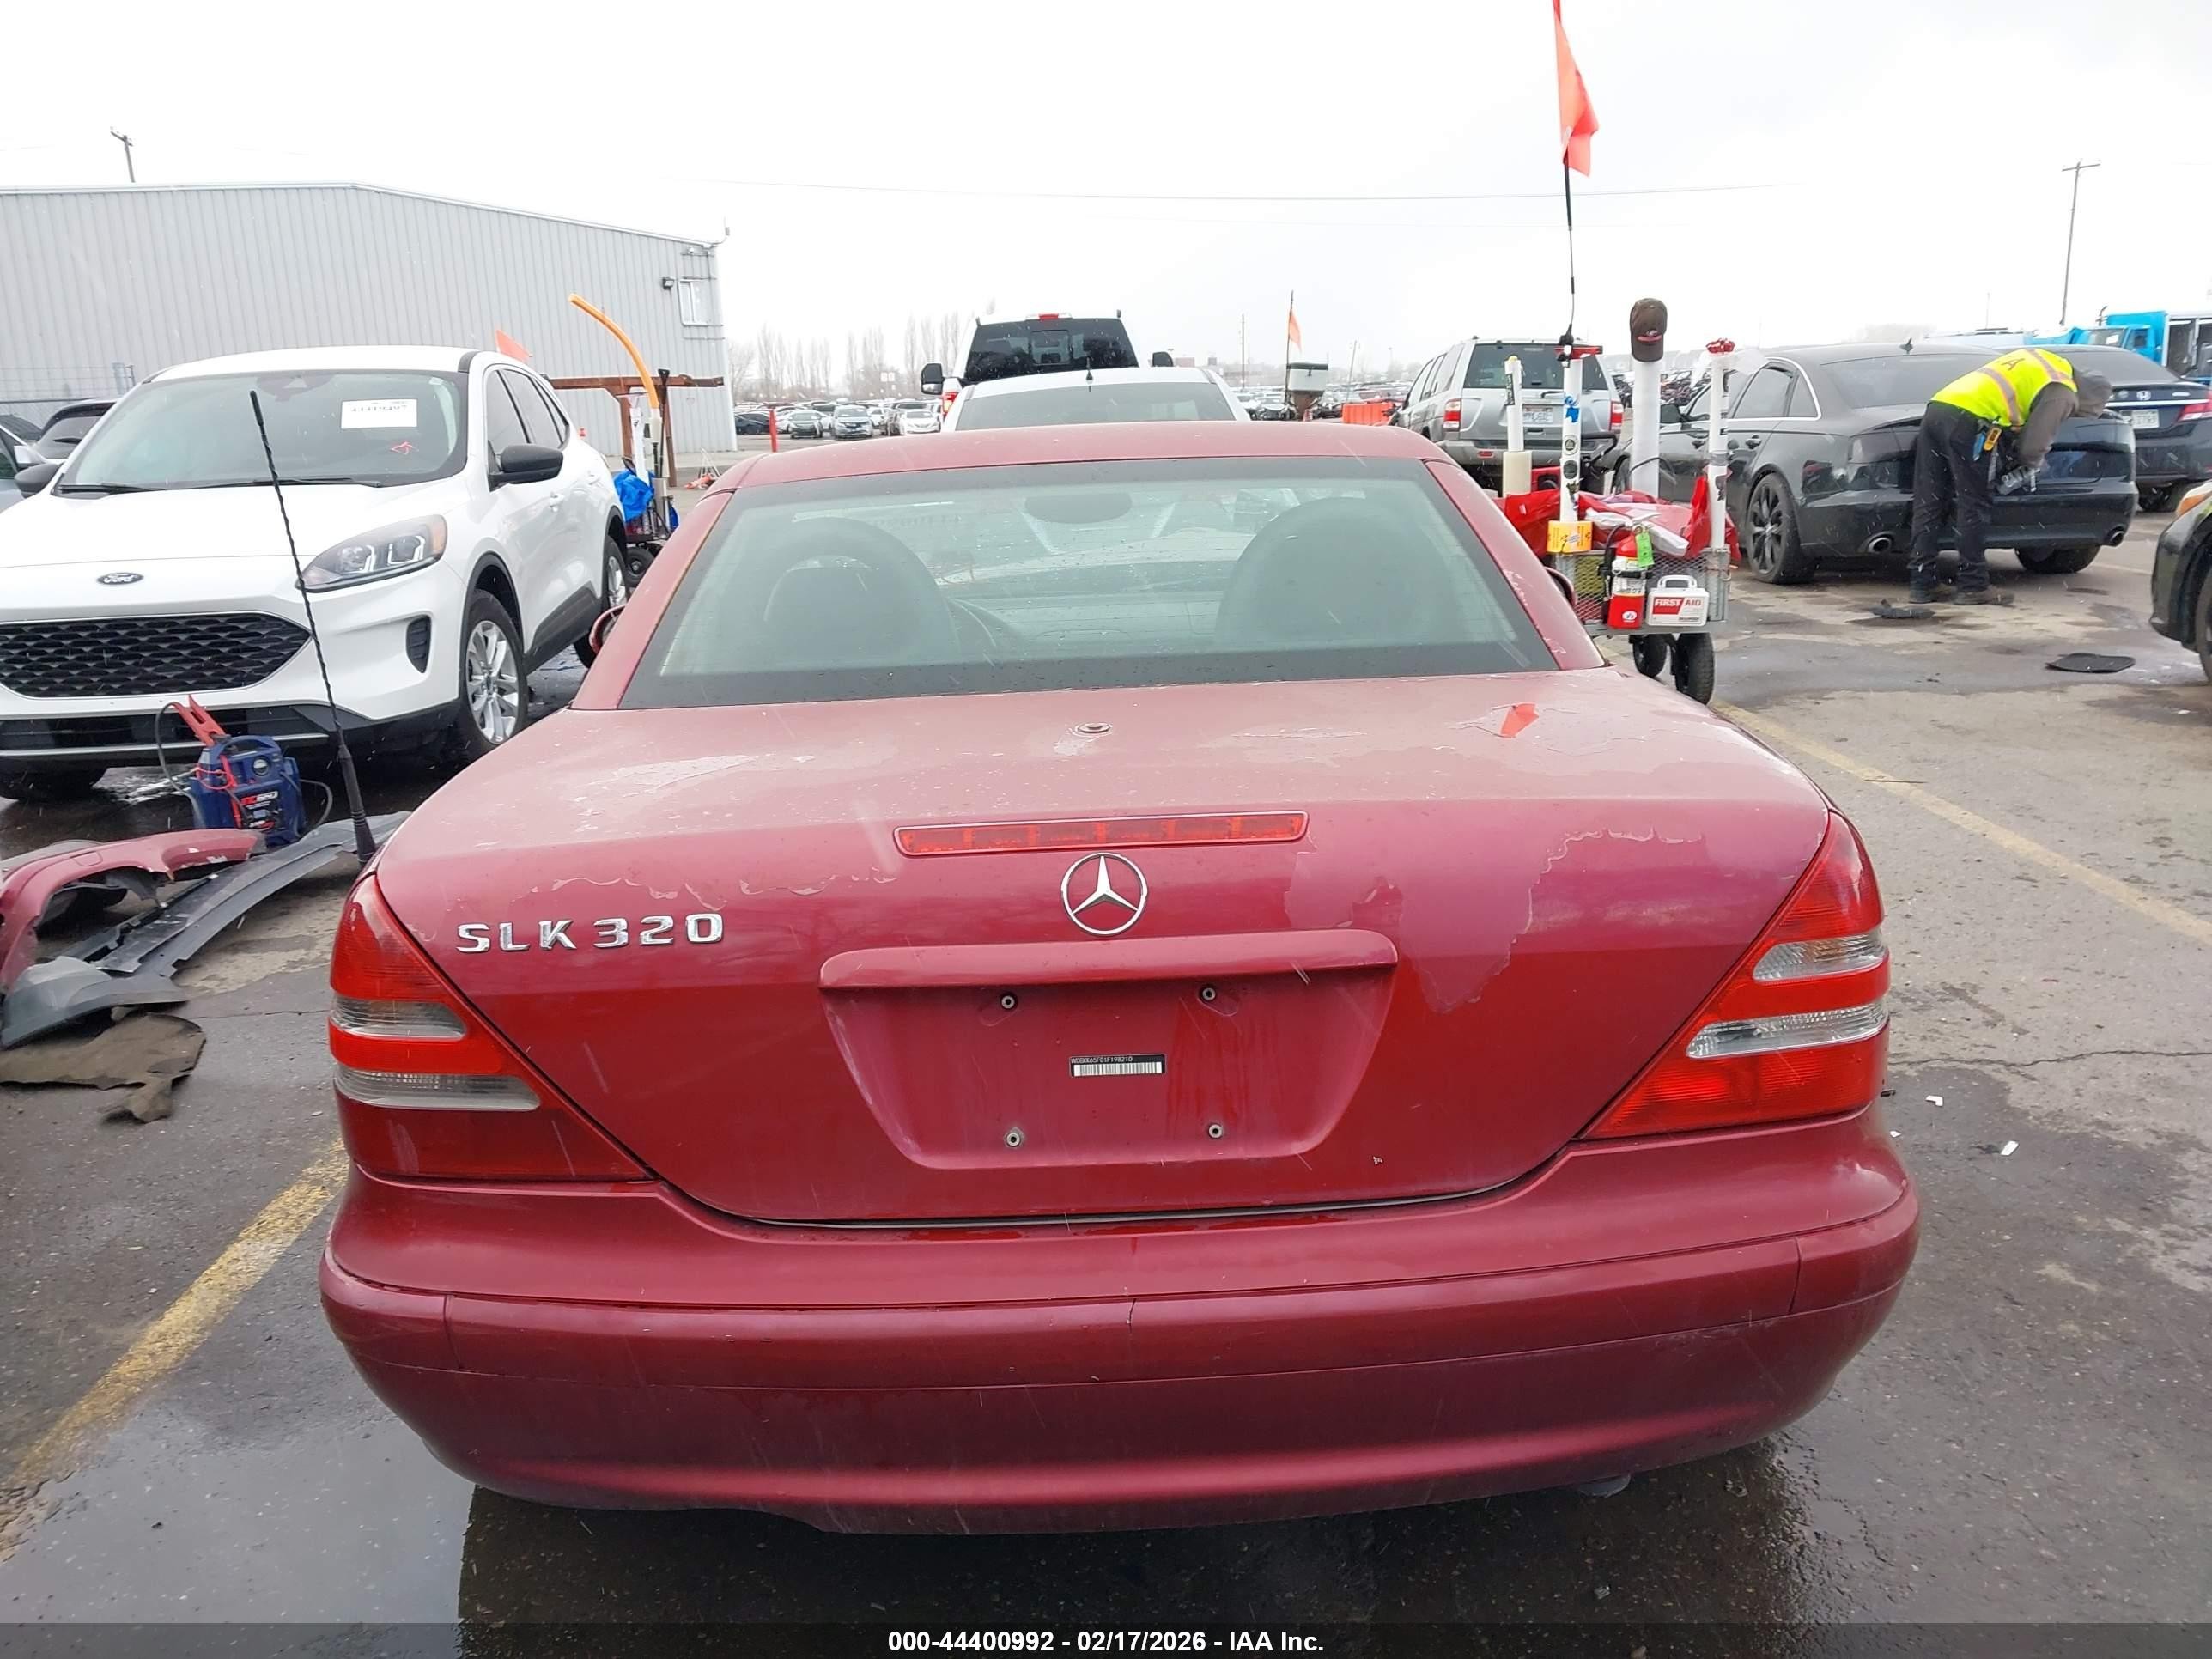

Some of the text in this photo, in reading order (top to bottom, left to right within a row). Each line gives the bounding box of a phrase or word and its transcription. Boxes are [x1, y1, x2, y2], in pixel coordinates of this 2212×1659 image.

[1654, 598, 1702, 607] FIRST AID
[456, 913, 724, 952] SLK 320
